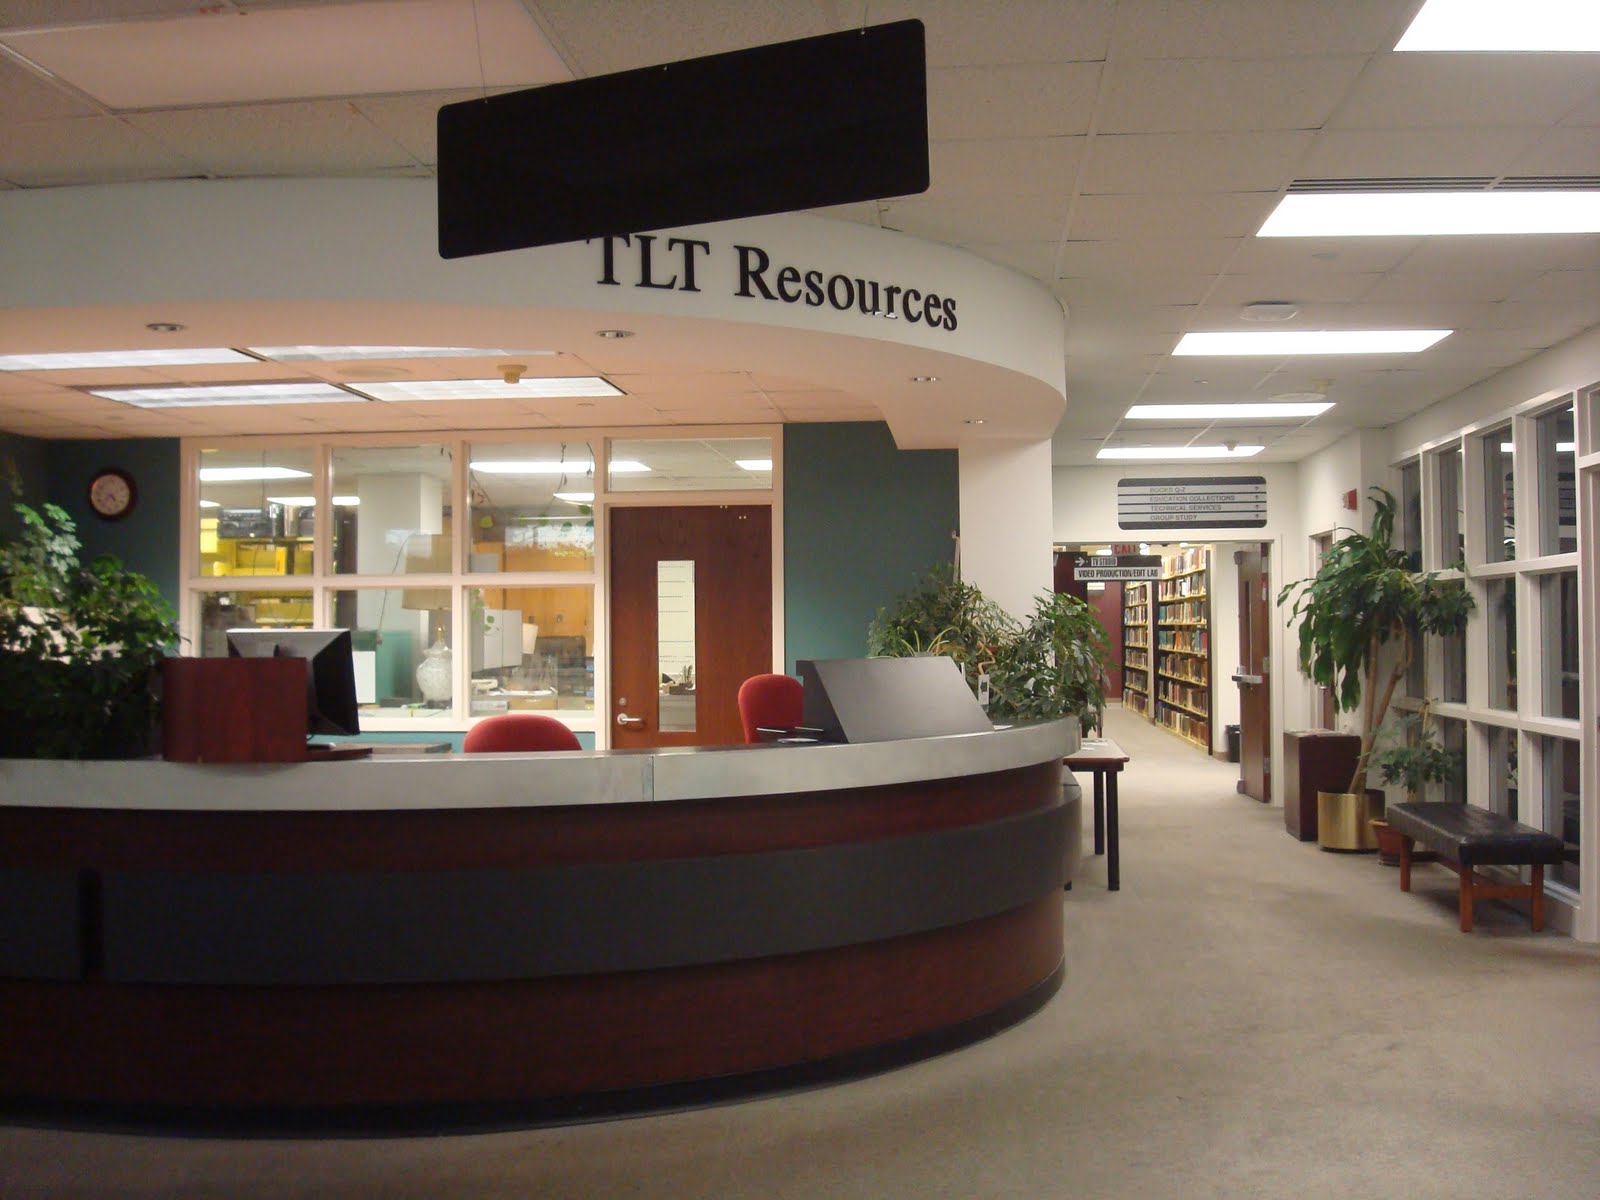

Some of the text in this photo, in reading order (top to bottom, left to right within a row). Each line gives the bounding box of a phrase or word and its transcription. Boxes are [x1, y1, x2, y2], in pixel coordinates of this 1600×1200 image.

[586, 233, 959, 332] TLT Resources
[1099, 557, 1117, 566] STUDIO
[1079, 570, 1094, 578] VIDEO
[1147, 569, 1158, 577] LAB
